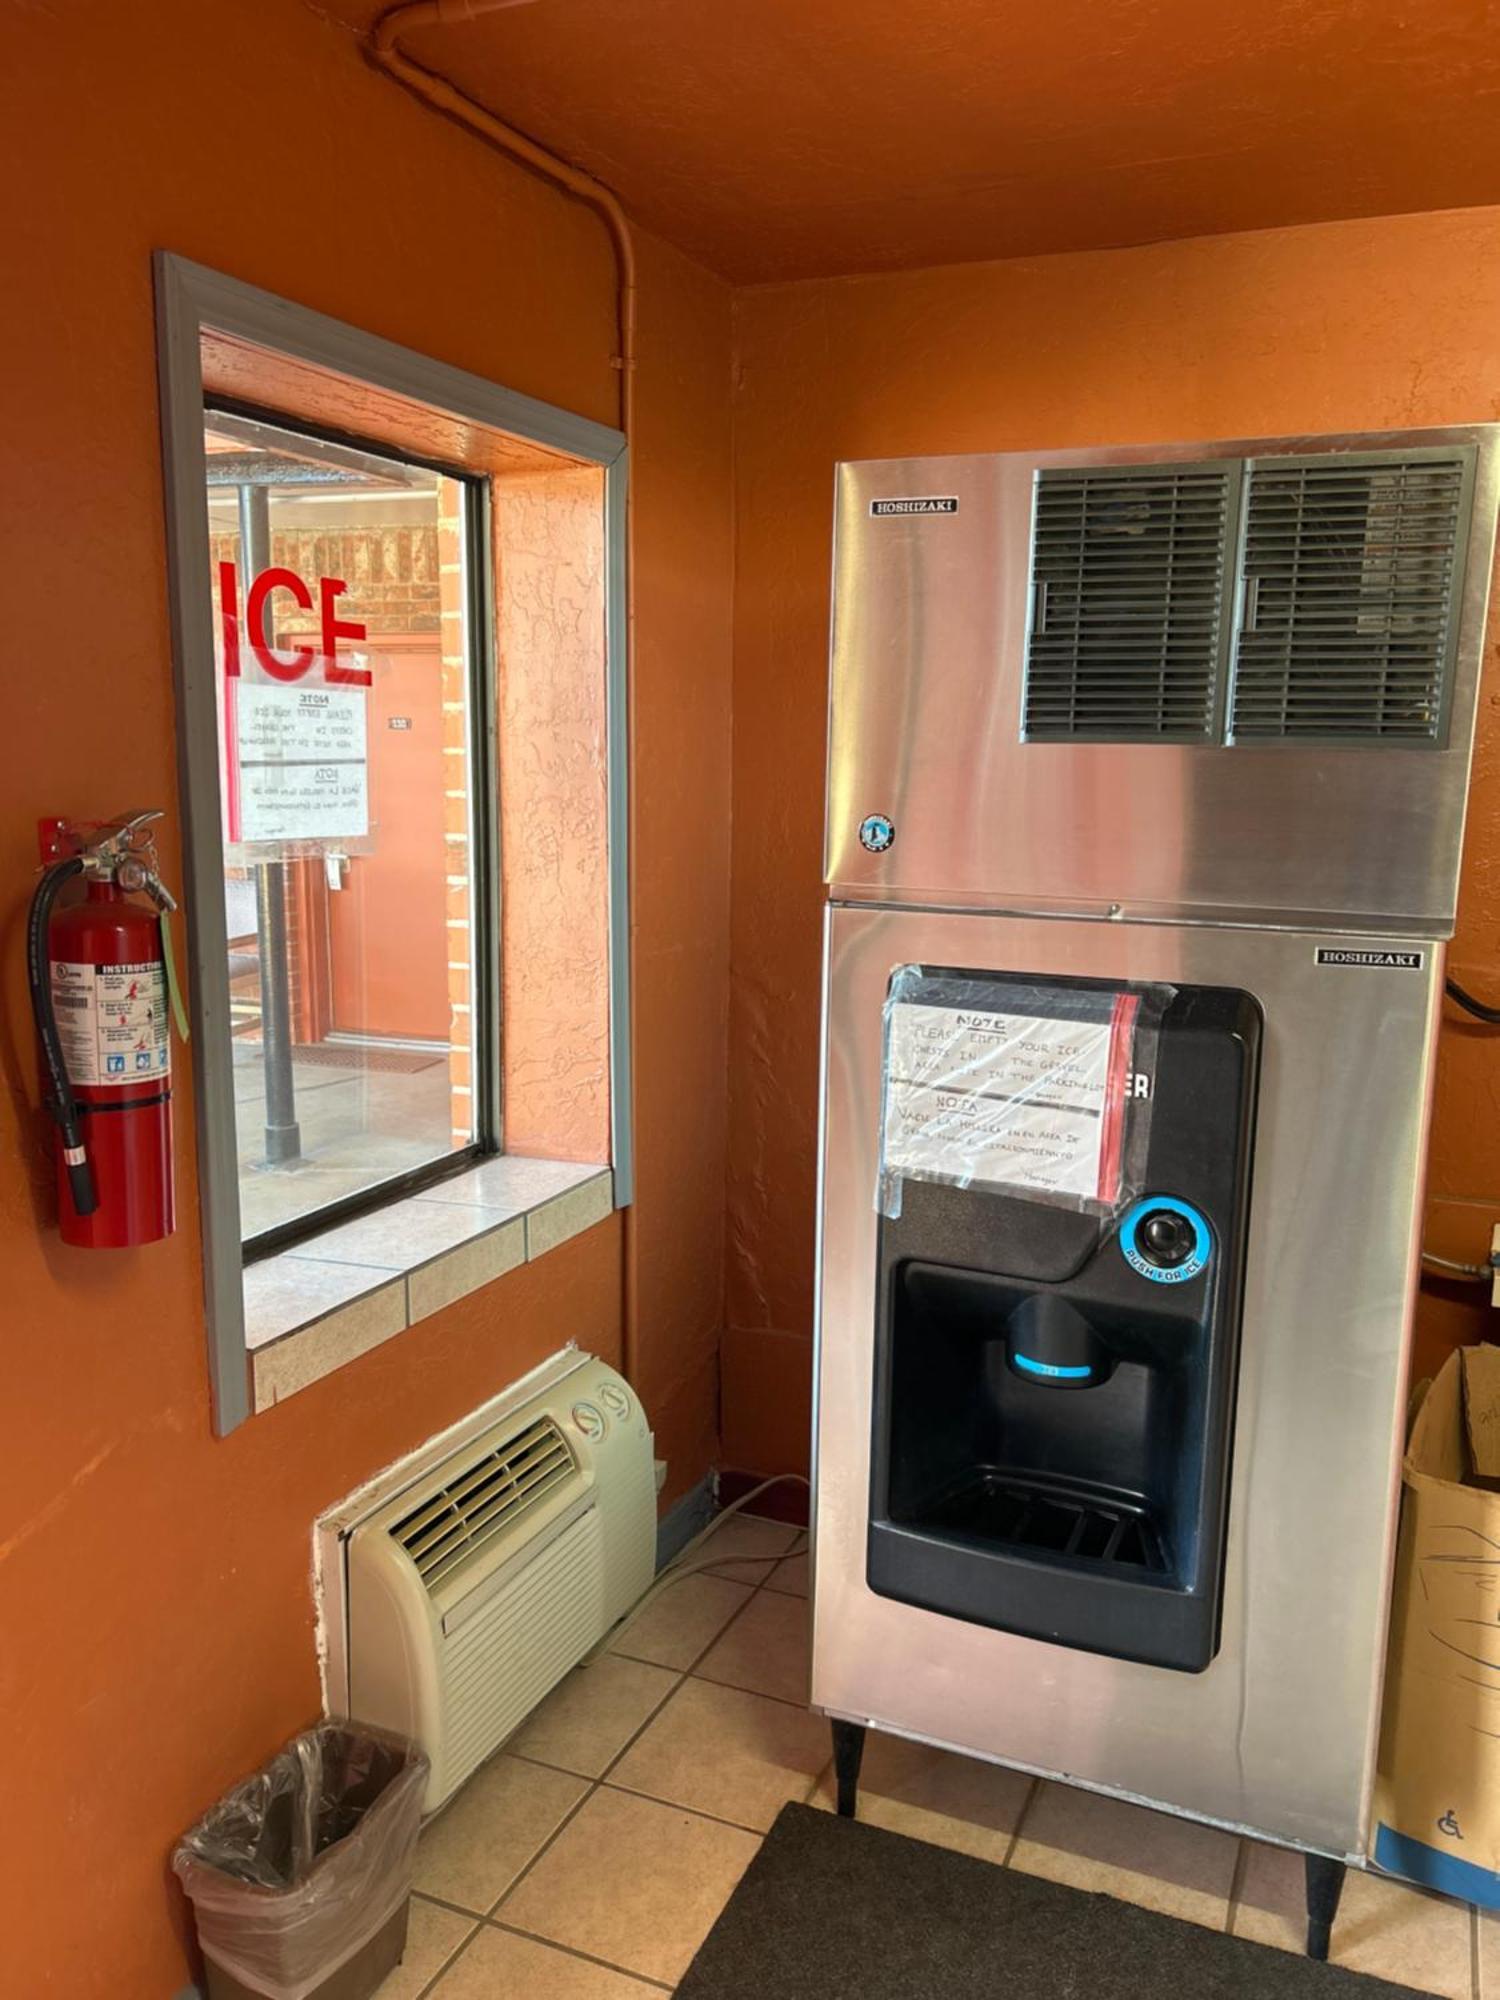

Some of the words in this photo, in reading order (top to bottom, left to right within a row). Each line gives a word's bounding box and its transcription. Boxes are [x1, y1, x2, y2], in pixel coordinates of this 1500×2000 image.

[876, 500, 952, 513] HOSHIZAKI
[219, 561, 373, 687] ICE
[1323, 951, 1415, 966] HOSHIZAKI
[956, 1015, 1006, 1030] NOTE
[913, 1024, 960, 1041] PLEAS
[1126, 1249, 1154, 1278] PUSH
[1157, 1269, 1182, 1281] FOR
[1184, 1260, 1202, 1276] ICE
